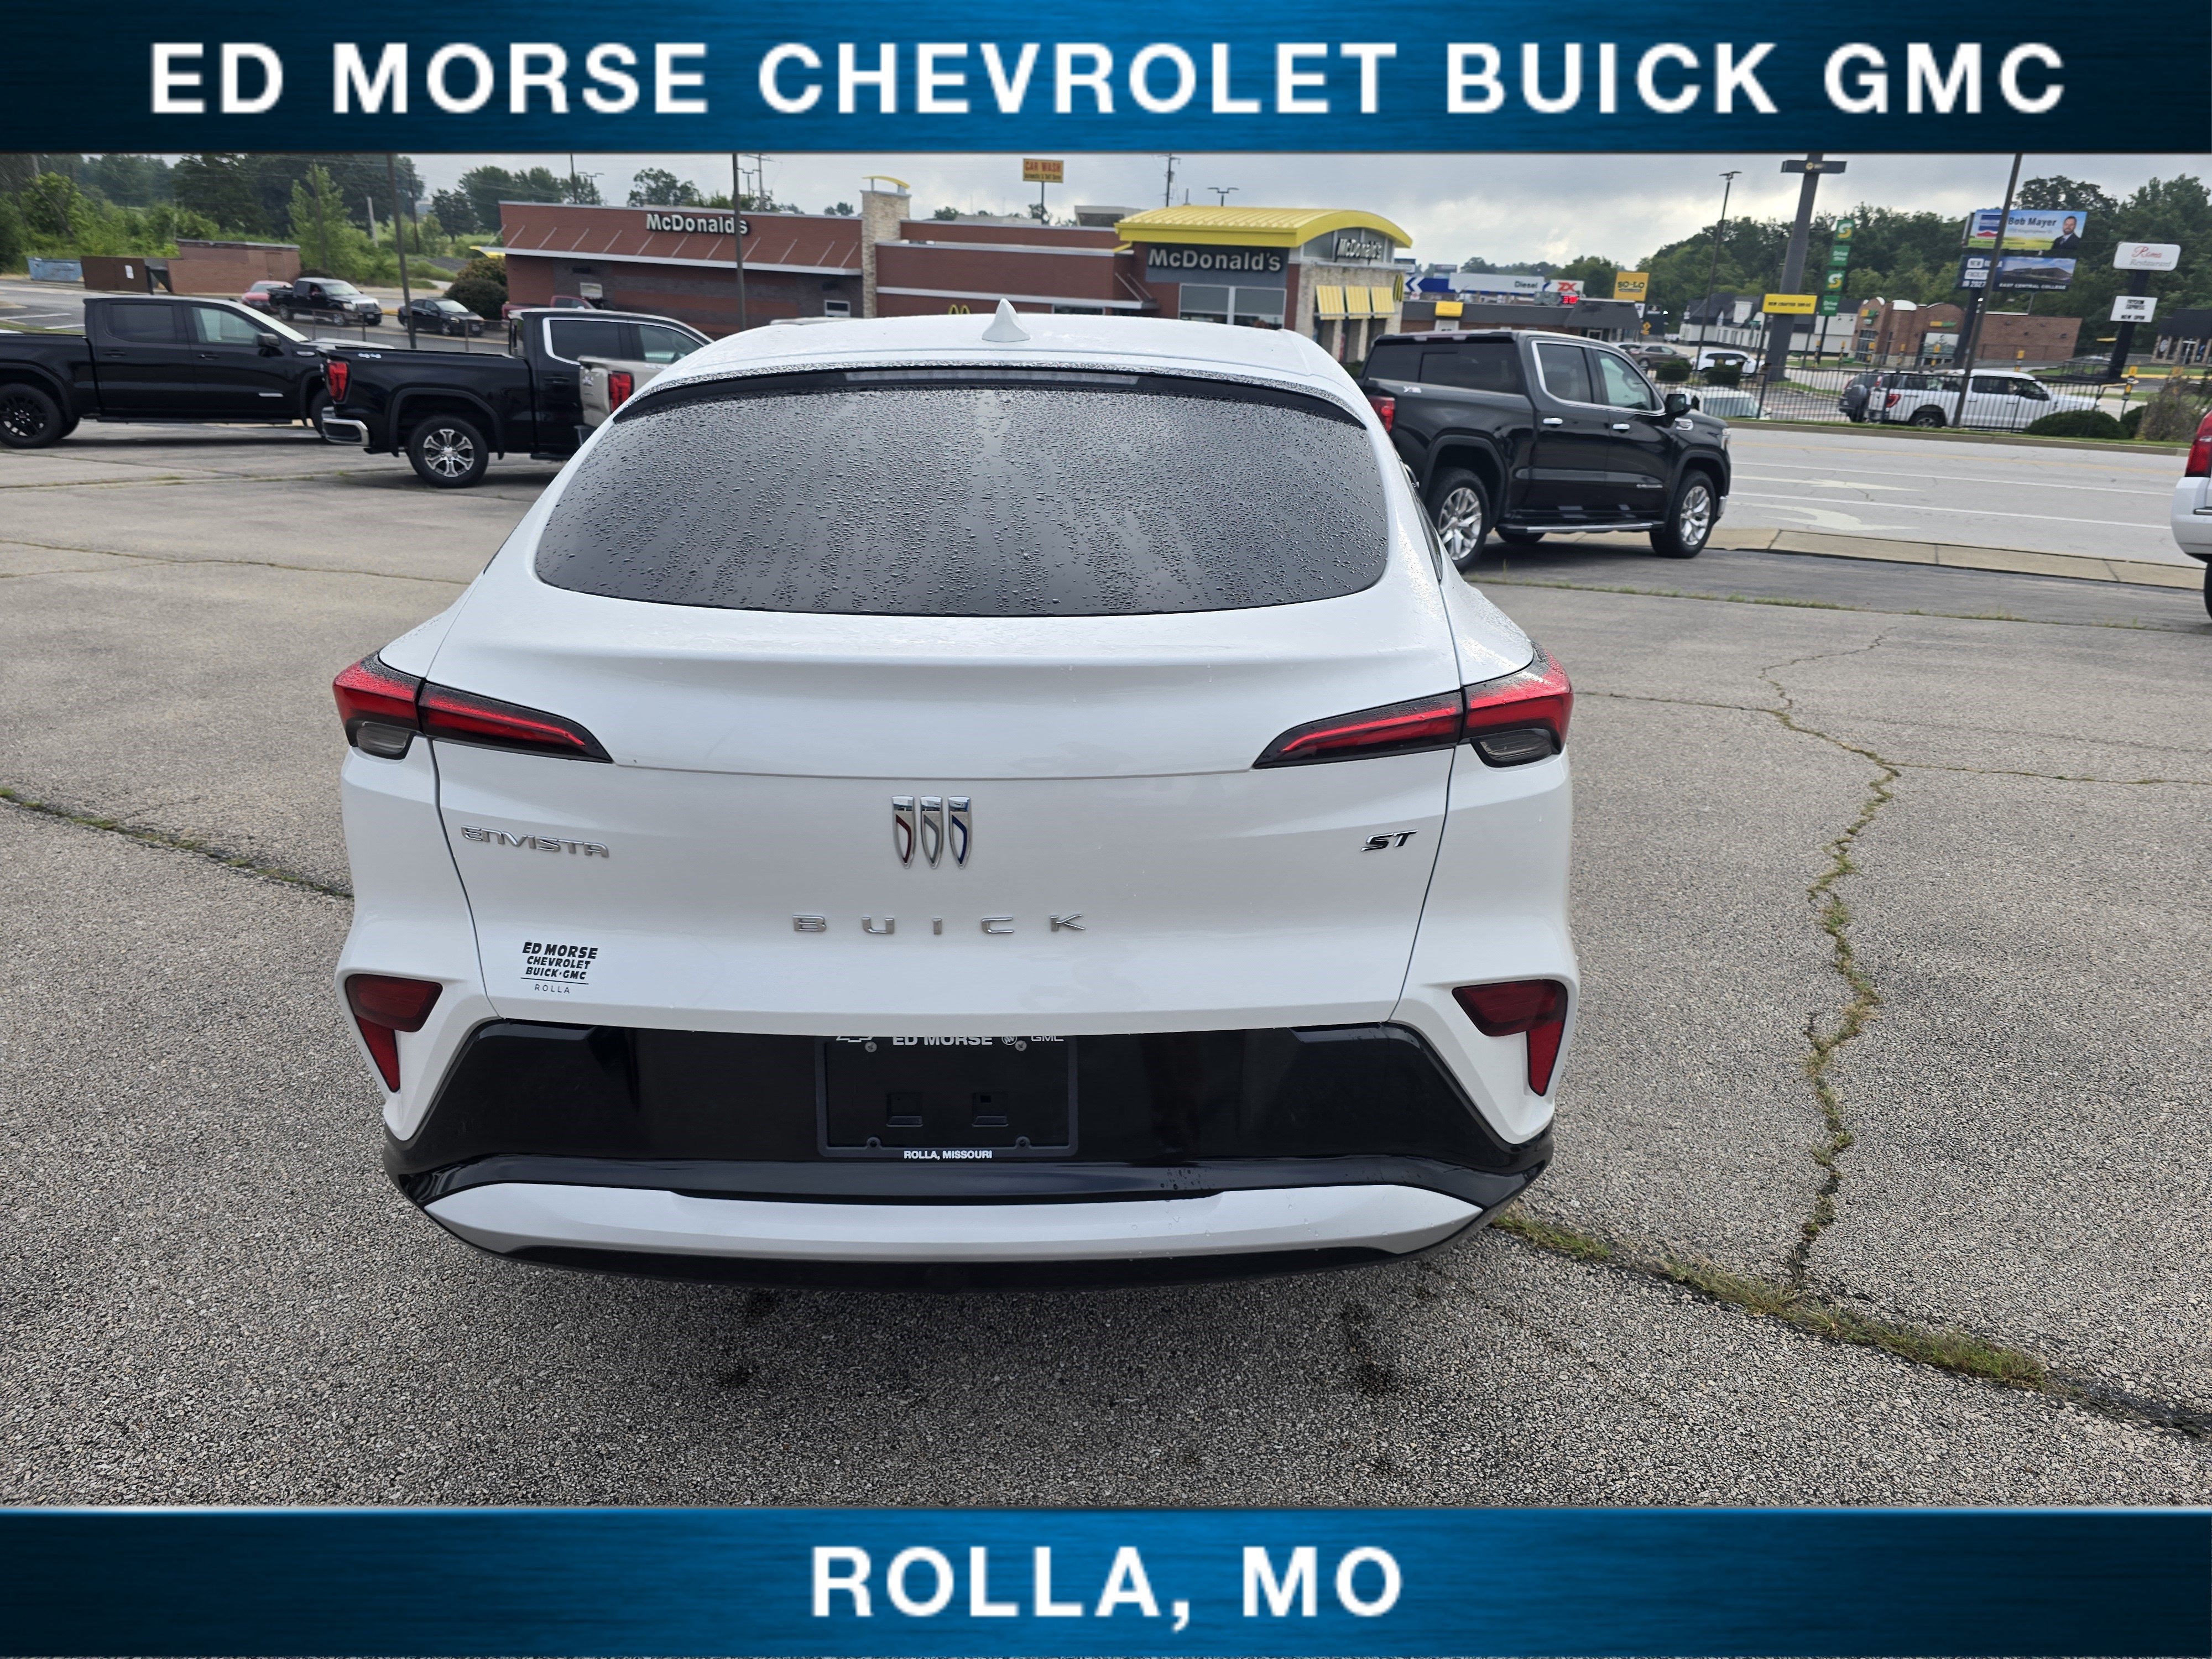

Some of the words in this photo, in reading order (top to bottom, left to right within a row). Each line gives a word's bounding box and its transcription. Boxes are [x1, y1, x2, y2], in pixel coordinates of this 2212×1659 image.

[646, 213, 748, 234] McDonalds
[2008, 217, 2026, 225] Bob
[2027, 217, 2057, 228] Mayer
[1149, 248, 1281, 271] McDonald's
[1515, 280, 1538, 289] Diesel
[1360, 829, 1419, 852] ST
[792, 914, 1086, 935] BUICK
[523, 942, 542, 954] ED
[544, 943, 598, 959] MORSE
[526, 956, 591, 969] CHEVROLET
[534, 984, 570, 994] ROLLA
[892, 1036, 918, 1046] ED
[924, 1036, 993, 1046] MORSE
[904, 1150, 940, 1160] ROLLA,
[942, 1150, 993, 1159] MISSOURI
